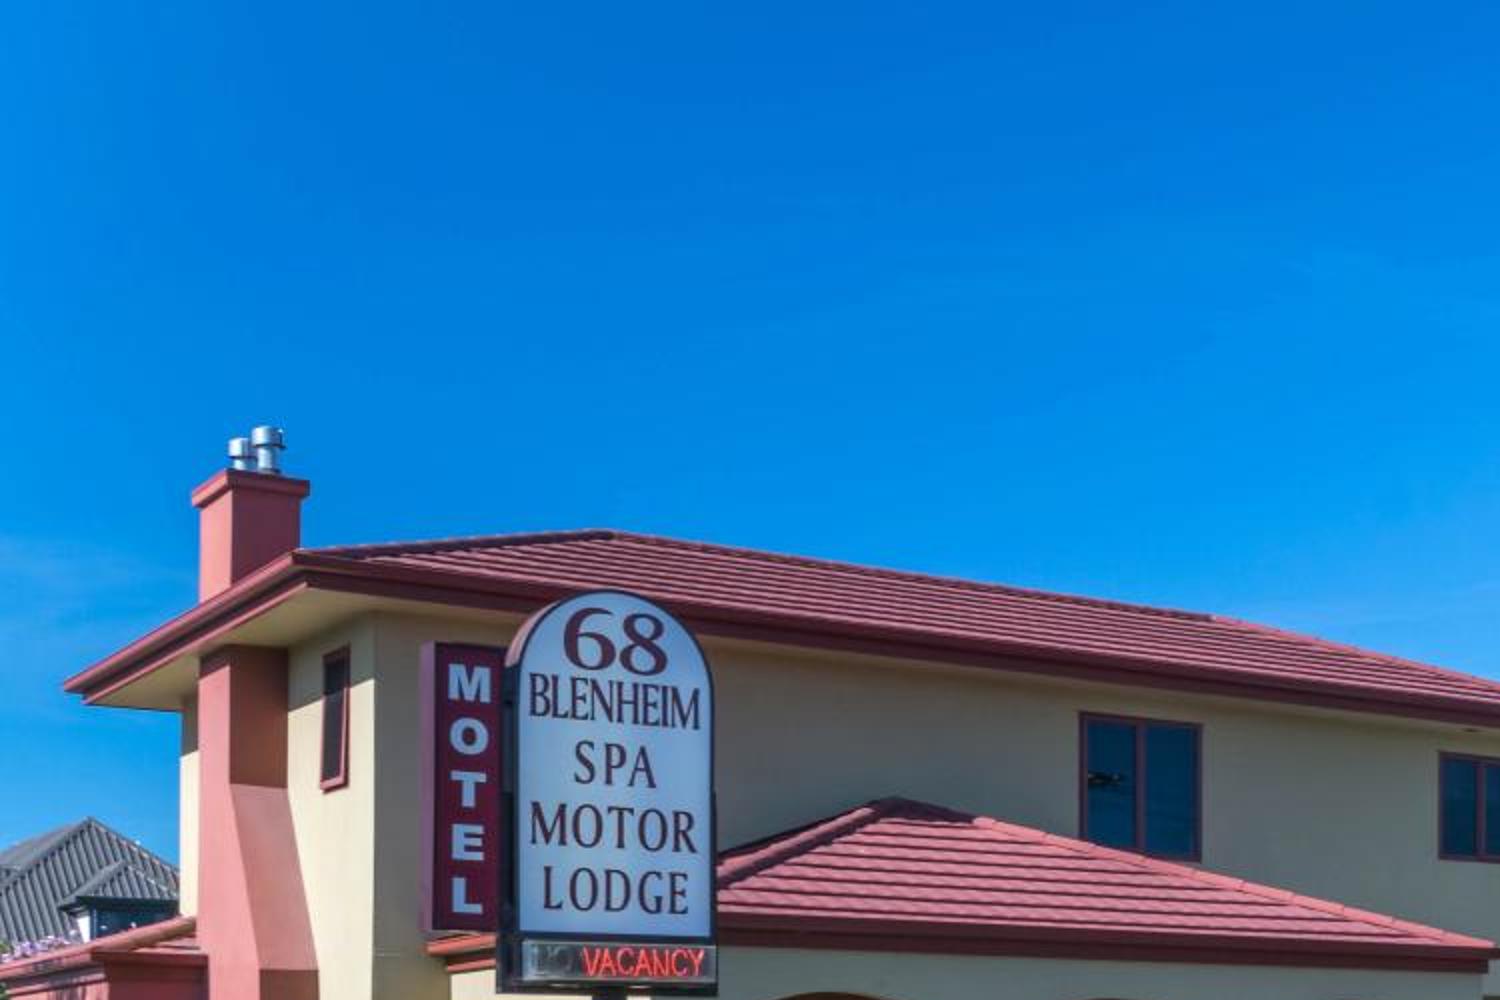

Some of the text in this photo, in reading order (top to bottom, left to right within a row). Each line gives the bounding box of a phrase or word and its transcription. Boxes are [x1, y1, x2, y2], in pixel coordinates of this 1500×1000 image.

[563, 607, 669, 676] 68
[529, 672, 701, 730] BLENHEIM
[448, 663, 491, 916] MOTEL
[573, 740, 657, 788] SPA
[530, 801, 698, 854] MOTOR
[543, 865, 689, 915] LODGE
[582, 946, 705, 978] VACANCY
